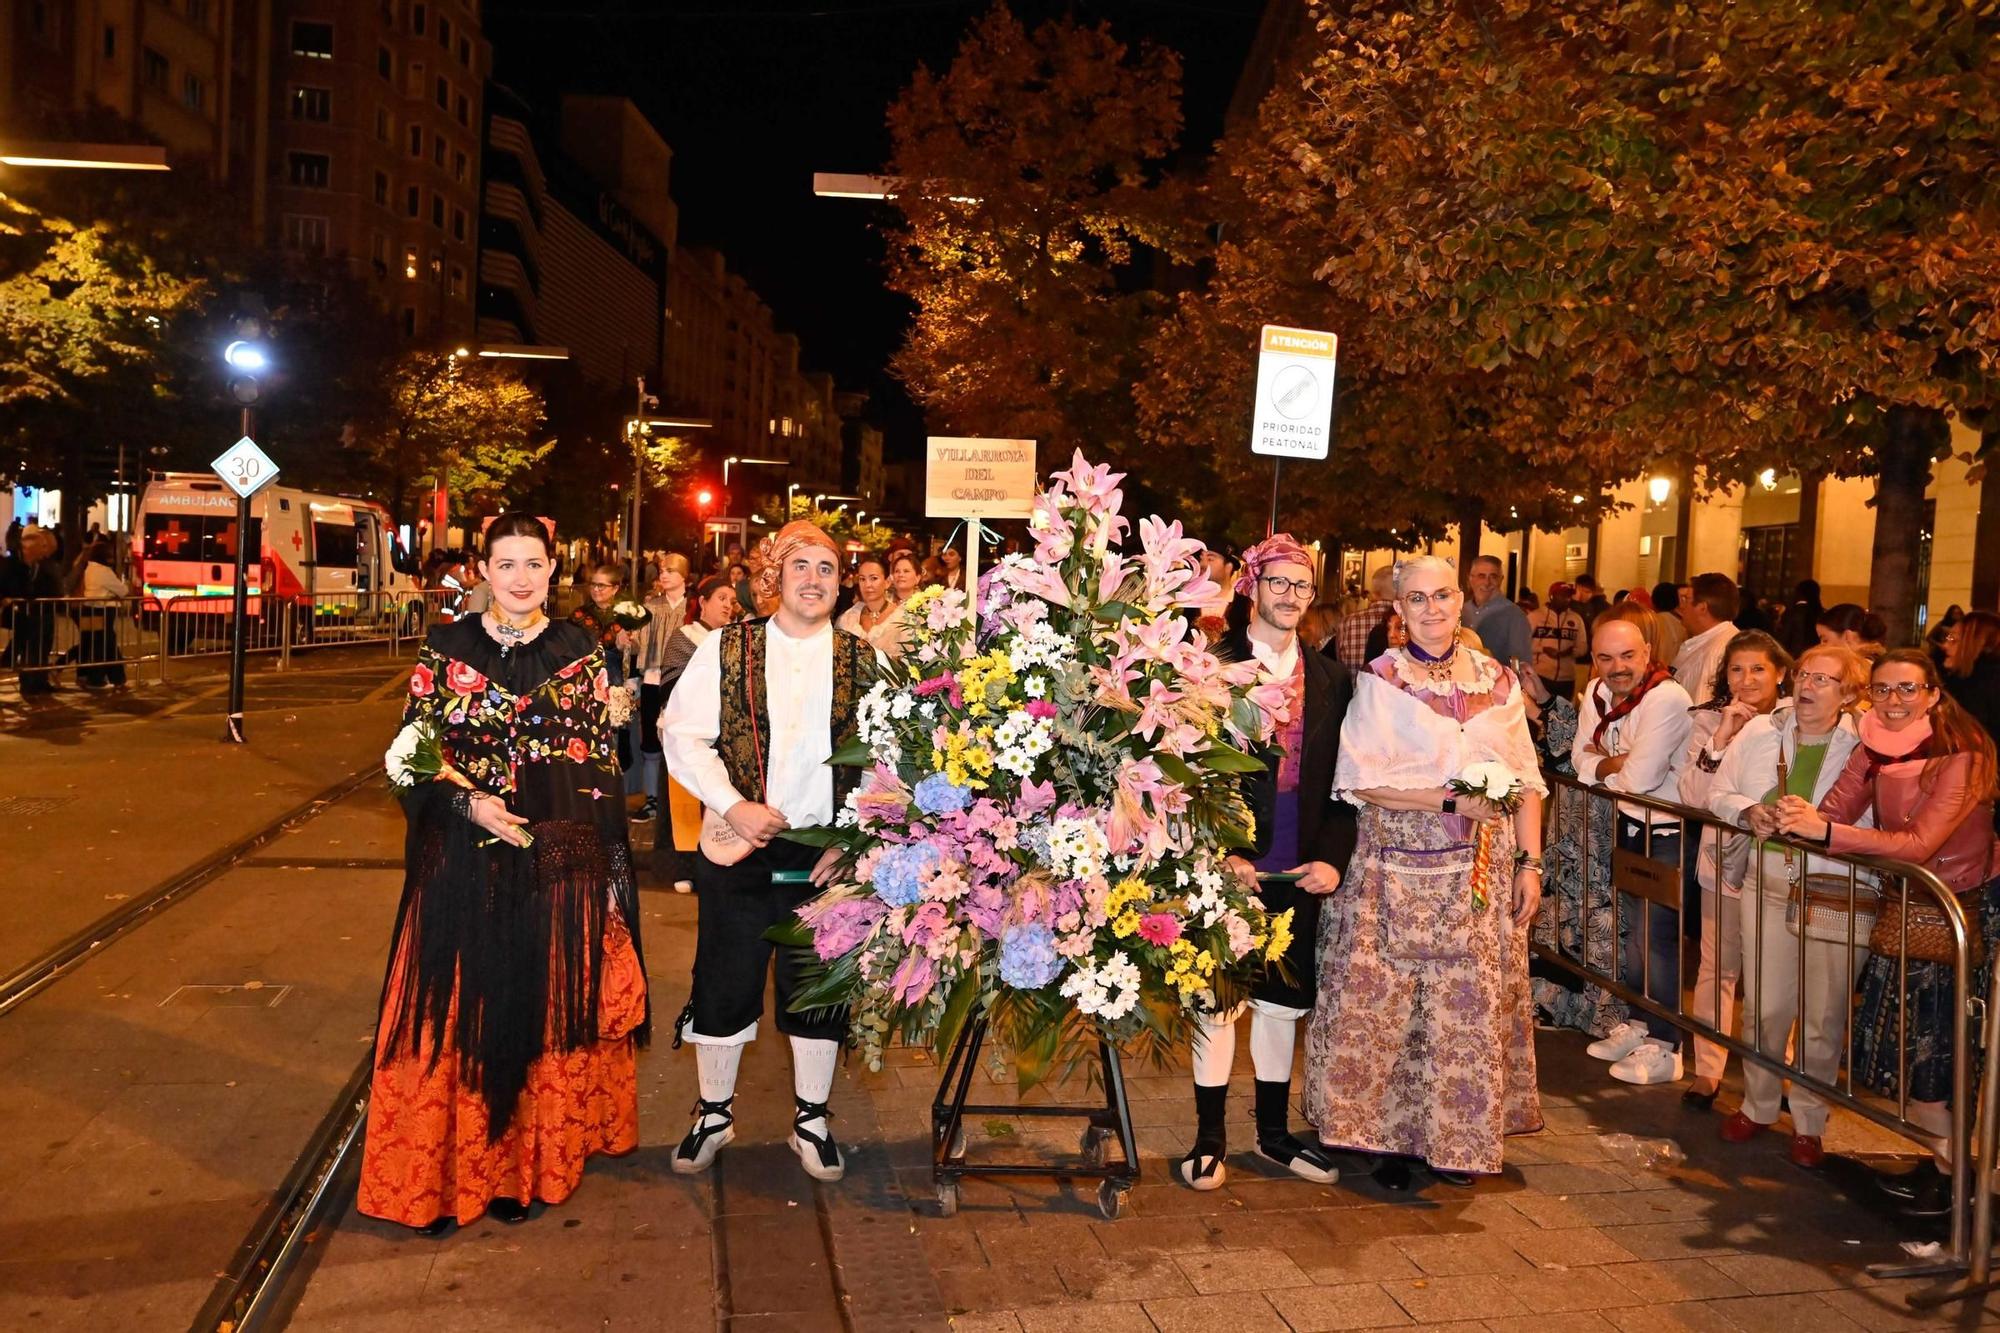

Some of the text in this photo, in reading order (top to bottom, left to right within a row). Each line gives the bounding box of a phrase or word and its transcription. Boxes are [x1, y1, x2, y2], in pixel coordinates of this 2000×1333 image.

[1270, 335, 1329, 351] ATENCIÓN
[1263, 422, 1322, 436] PRIORIDAD
[1262, 437, 1319, 451] PEATONAL
[936, 447, 1028, 463] VILLARROYA
[231, 456, 260, 478] 30
[965, 467, 996, 481] DEL
[951, 487, 1008, 502] CAMPO
[159, 495, 236, 509] AMBULANC
